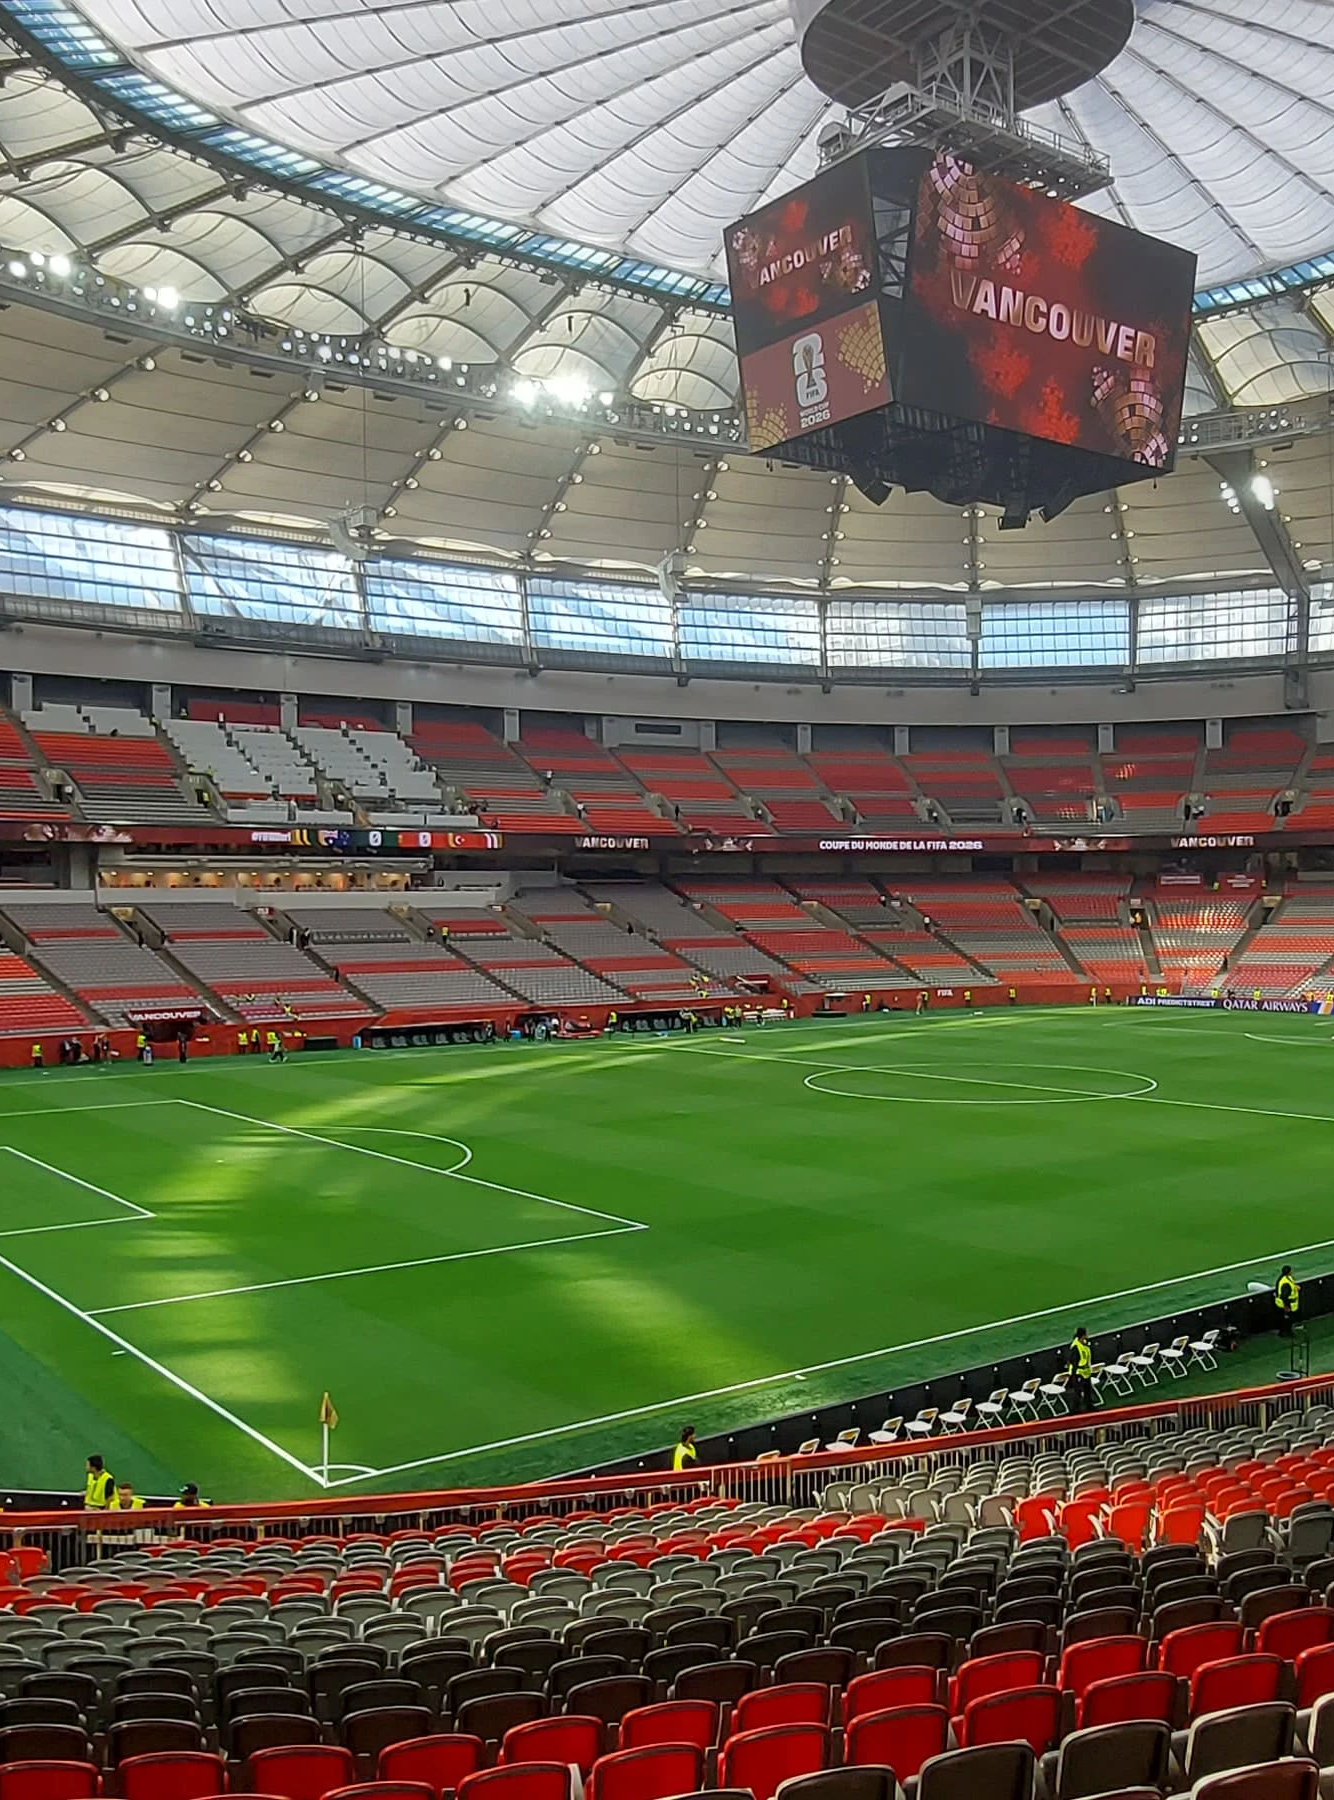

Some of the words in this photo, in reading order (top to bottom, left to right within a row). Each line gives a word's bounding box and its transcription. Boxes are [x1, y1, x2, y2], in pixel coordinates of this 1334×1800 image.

[753, 224, 852, 289] VANCOUVER
[951, 270, 1156, 369] VANCOUVER
[806, 389, 820, 399] FIFA
[801, 410, 831, 428] 2026
[575, 837, 648, 849] VANCOUVER
[820, 841, 850, 850] COUPE
[851, 841, 864, 850] DU
[866, 841, 898, 850] MONDE
[899, 841, 912, 850] DE
[913, 841, 925, 850] LA
[927, 841, 947, 850] FIFA
[949, 841, 982, 850] 2026
[1171, 836, 1253, 848] VANCOUVER
[1137, 997, 1155, 1006] ADI
[1223, 999, 1258, 1011] QATAR
[1261, 1001, 1308, 1013] AIRWAYS
[129, 1011, 201, 1020] VANCOUVER
